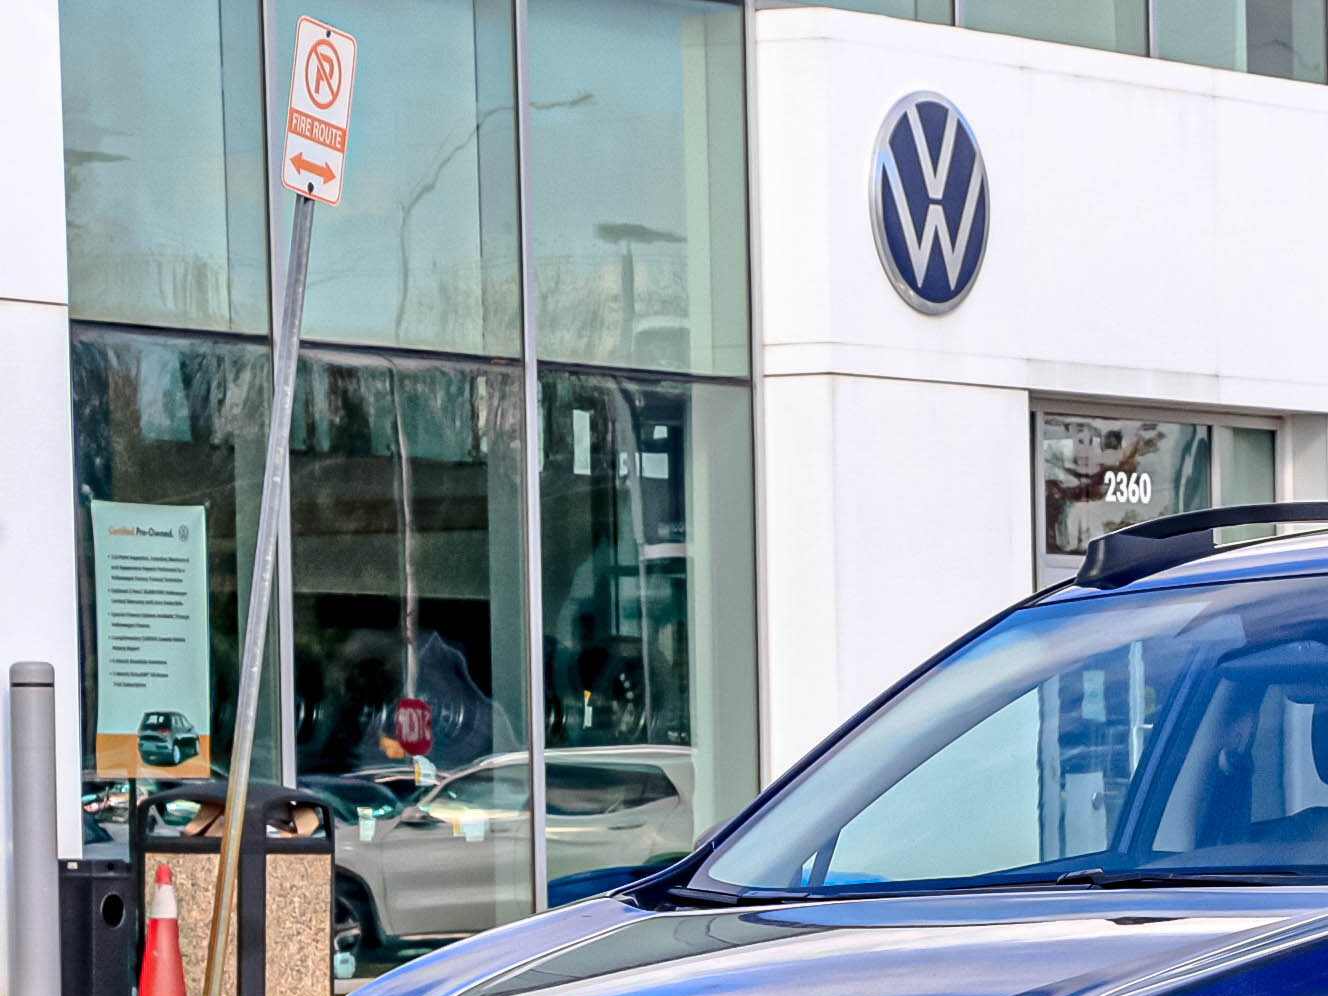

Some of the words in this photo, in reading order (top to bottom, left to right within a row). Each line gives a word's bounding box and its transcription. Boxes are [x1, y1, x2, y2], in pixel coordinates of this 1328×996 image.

[291, 112, 311, 137] FIRE
[312, 120, 343, 148] ROUTE
[874, 97, 986, 297] VW
[1103, 470, 1152, 505] 2360
